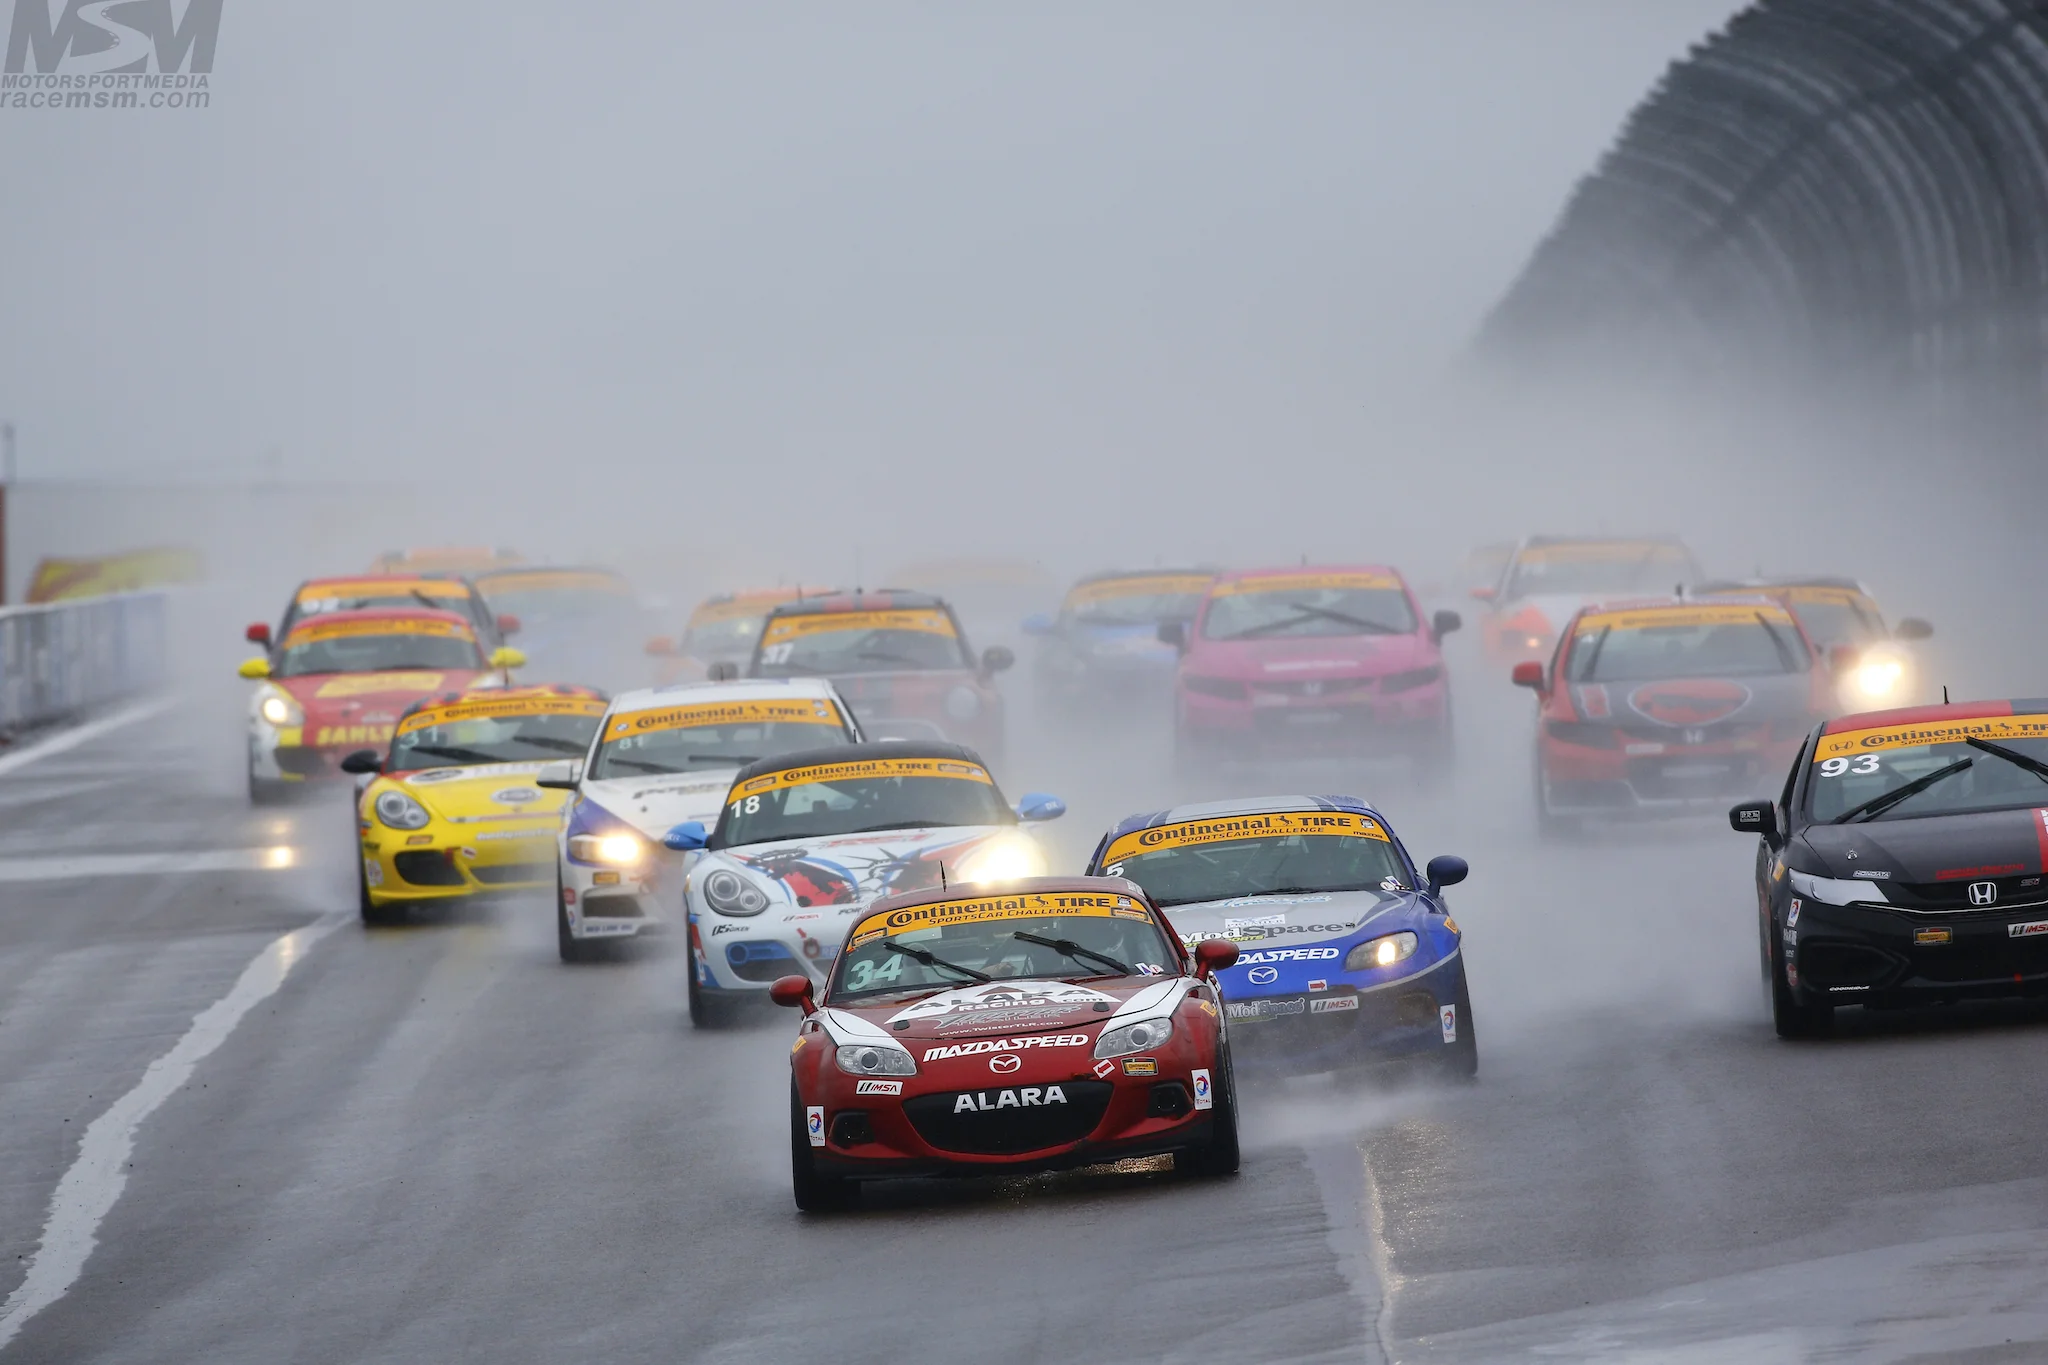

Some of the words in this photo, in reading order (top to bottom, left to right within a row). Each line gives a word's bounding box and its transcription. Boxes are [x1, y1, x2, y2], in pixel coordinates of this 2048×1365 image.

[636, 706, 744, 728] Continental
[766, 706, 809, 717] TIRE
[1860, 723, 1993, 748] Continental
[783, 762, 876, 782] Continental
[896, 762, 933, 771] TIRE
[1820, 755, 1880, 778] 93
[731, 795, 760, 819] 18
[1138, 816, 1271, 846] Continental
[1298, 817, 1352, 827] TIRE
[1179, 830, 1250, 844] SPORTSCAR
[1254, 827, 1325, 836] CHALLENGE
[1106, 862, 1125, 877] 5
[886, 897, 1028, 928] Continental
[1054, 897, 1111, 907] TIRE
[928, 911, 1003, 926] SPORTSCAR
[1007, 907, 1082, 916] CHALLENGE
[847, 953, 903, 991] 34
[958, 999, 1047, 1012] Racing
[1227, 1000, 1303, 1019] ModSpace
[1327, 1000, 1356, 1009] IMSA
[939, 1021, 1064, 1036] www.TwisterTLR.com
[922, 1034, 1089, 1062] MAZDASPEED
[870, 1083, 899, 1092] IMSA
[953, 1085, 1068, 1114] ALARA
